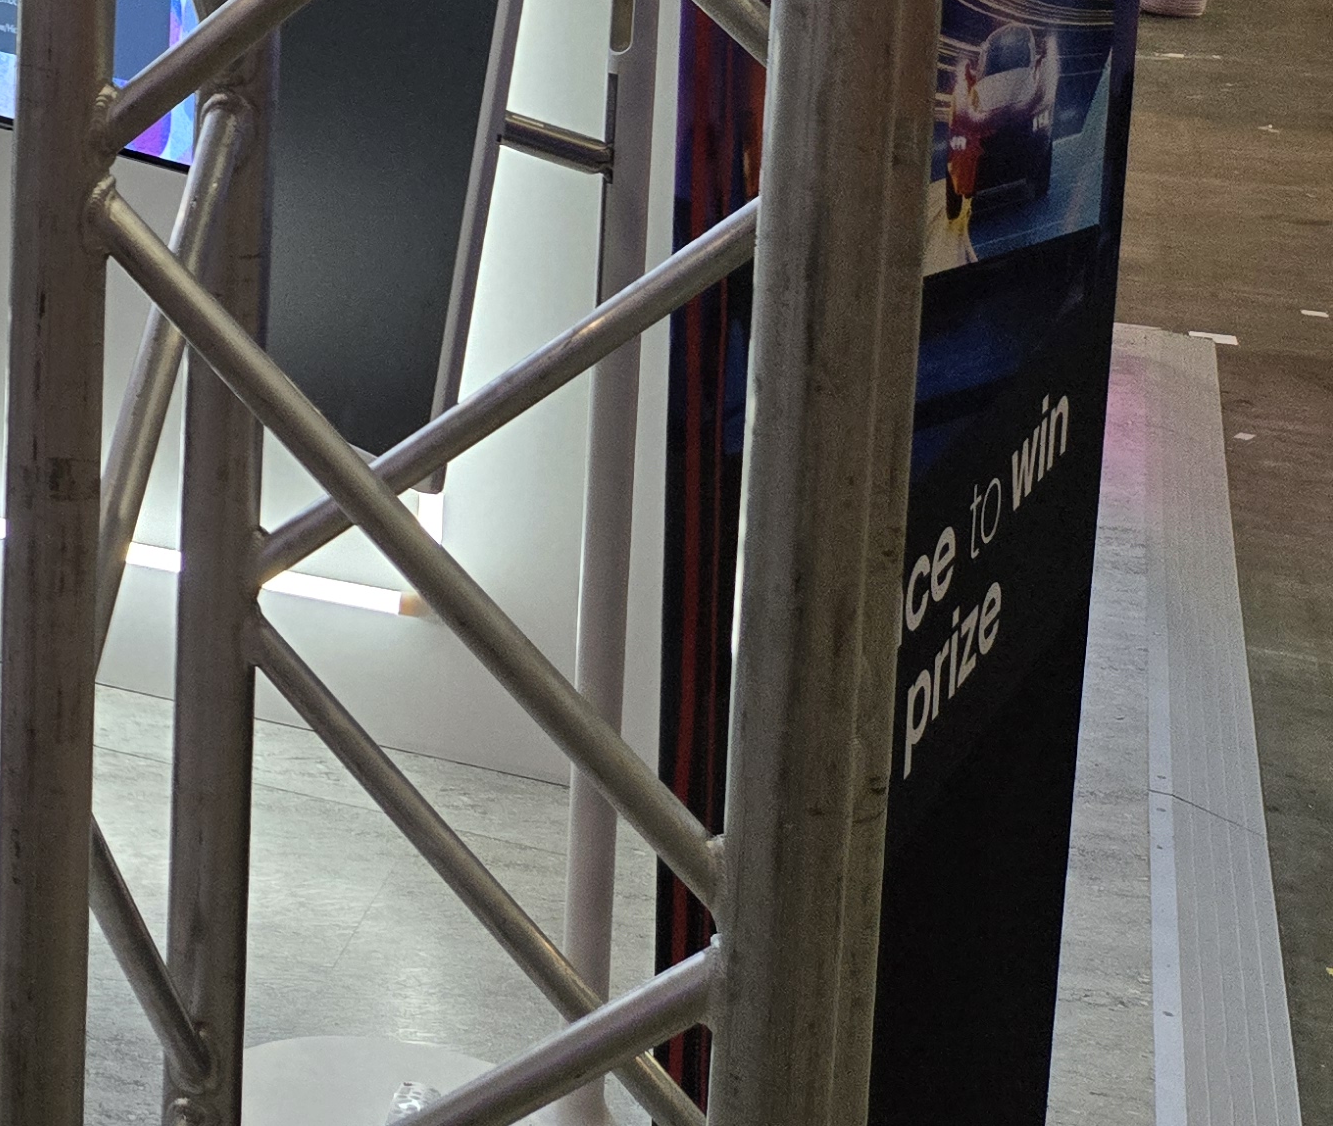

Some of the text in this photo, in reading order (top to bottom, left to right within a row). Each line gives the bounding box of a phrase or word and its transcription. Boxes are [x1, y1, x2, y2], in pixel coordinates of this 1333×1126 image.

[905, 393, 1070, 632] ce to win
[903, 581, 1002, 780] prize
